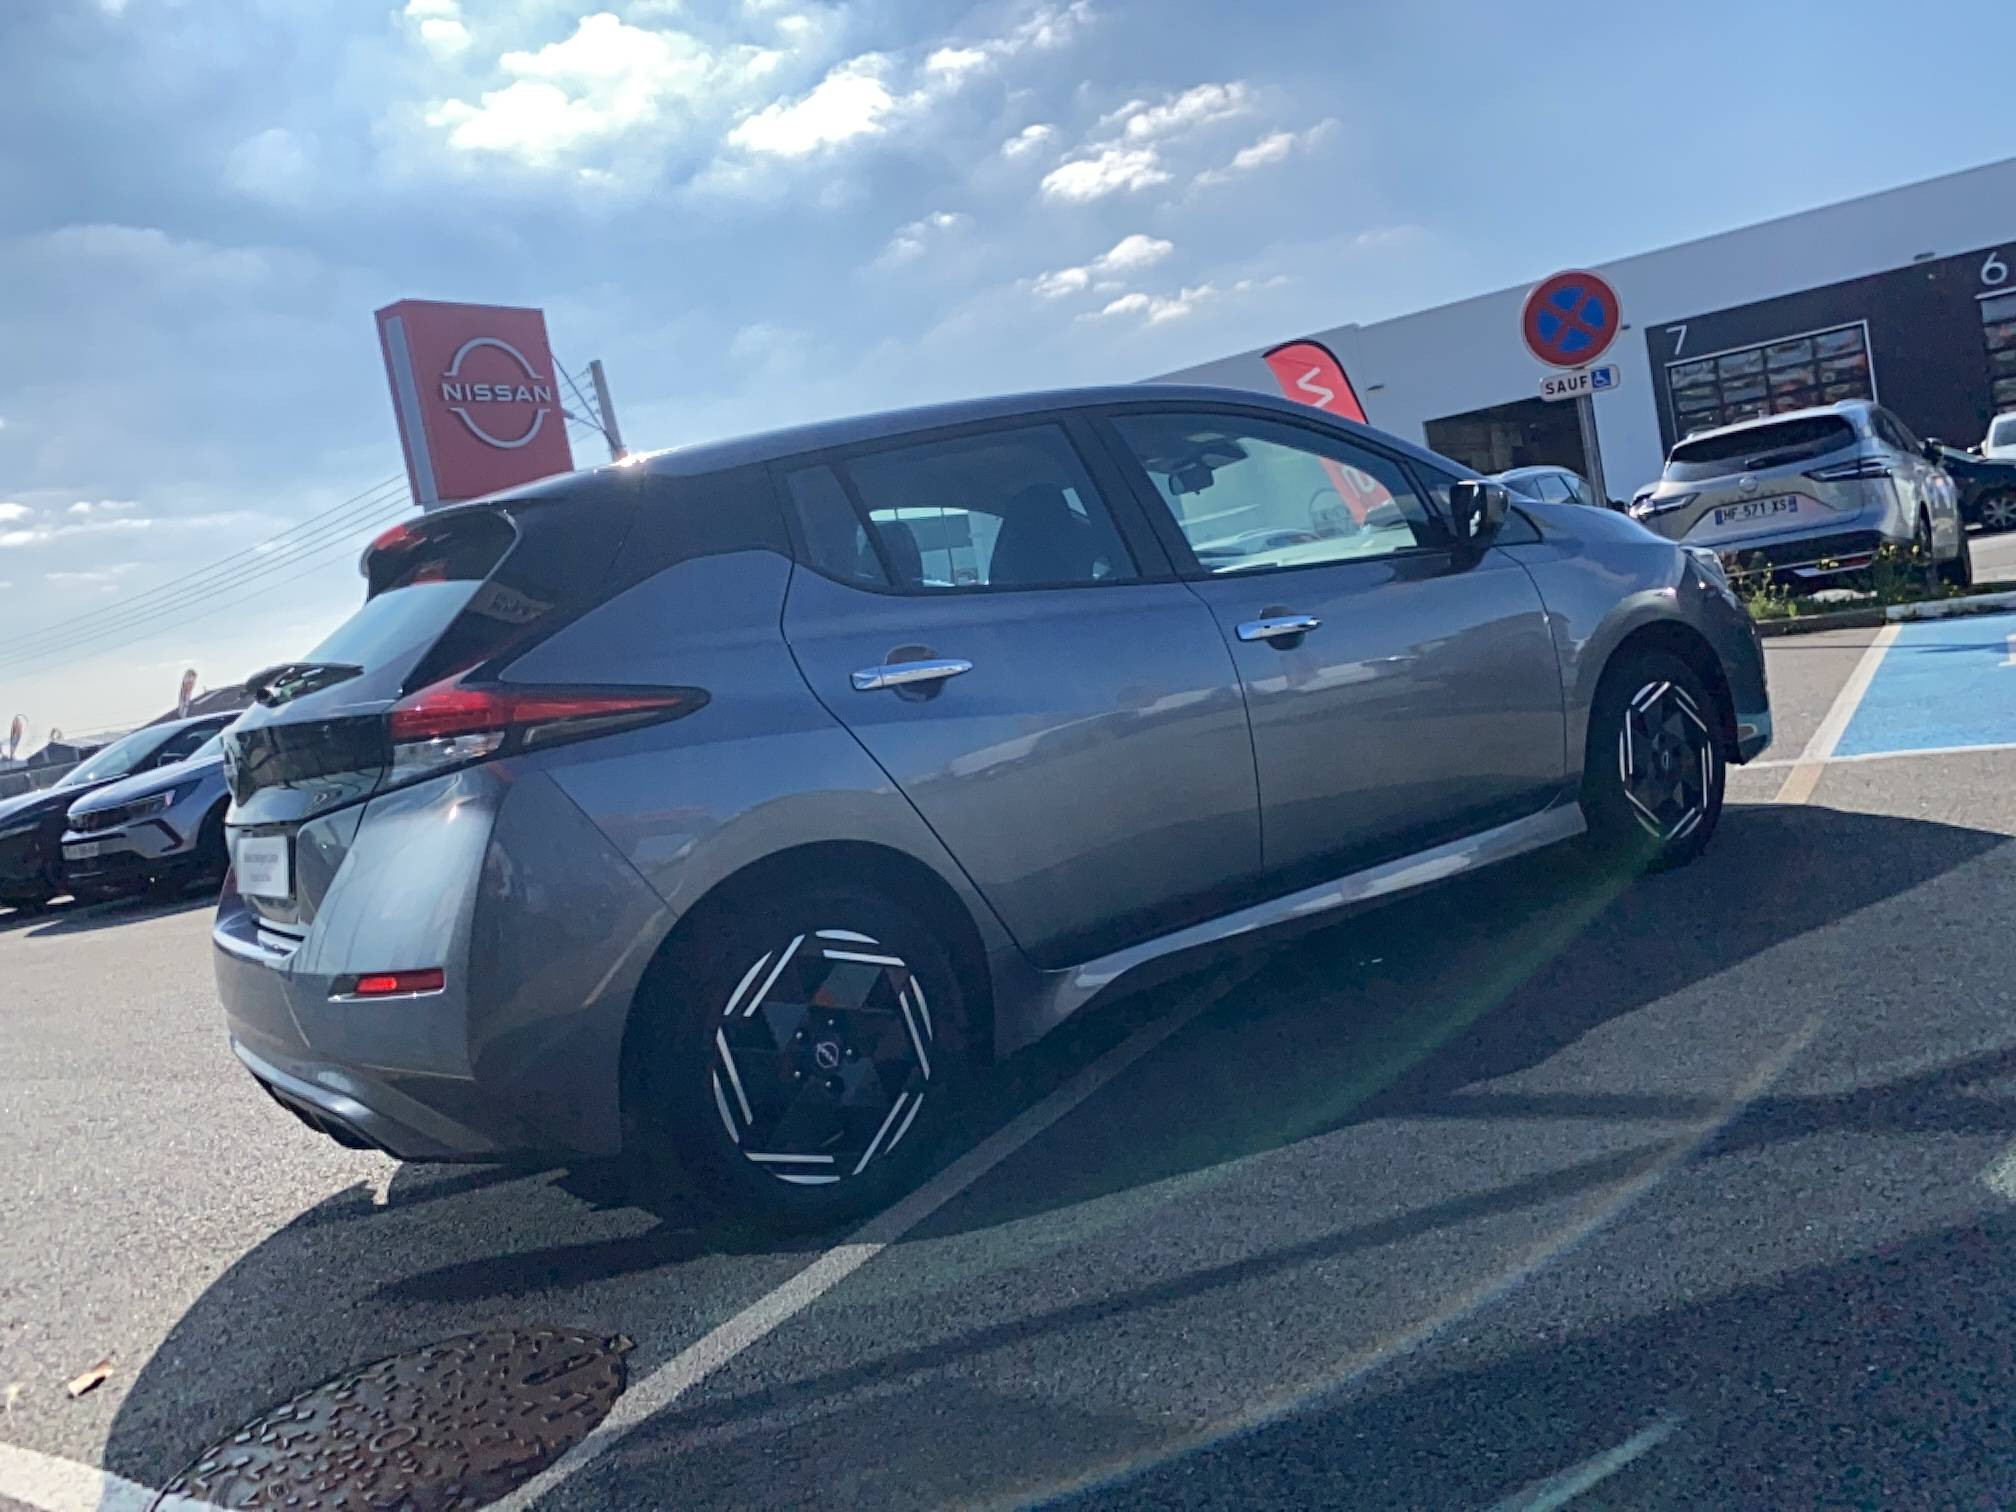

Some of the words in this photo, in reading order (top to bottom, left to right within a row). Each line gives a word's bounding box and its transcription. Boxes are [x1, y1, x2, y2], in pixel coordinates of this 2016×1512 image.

[1981, 251, 2008, 285] 6
[1665, 325, 1687, 355] 7
[442, 383, 552, 402] NISSAN
[1545, 375, 1588, 395] SAUF
